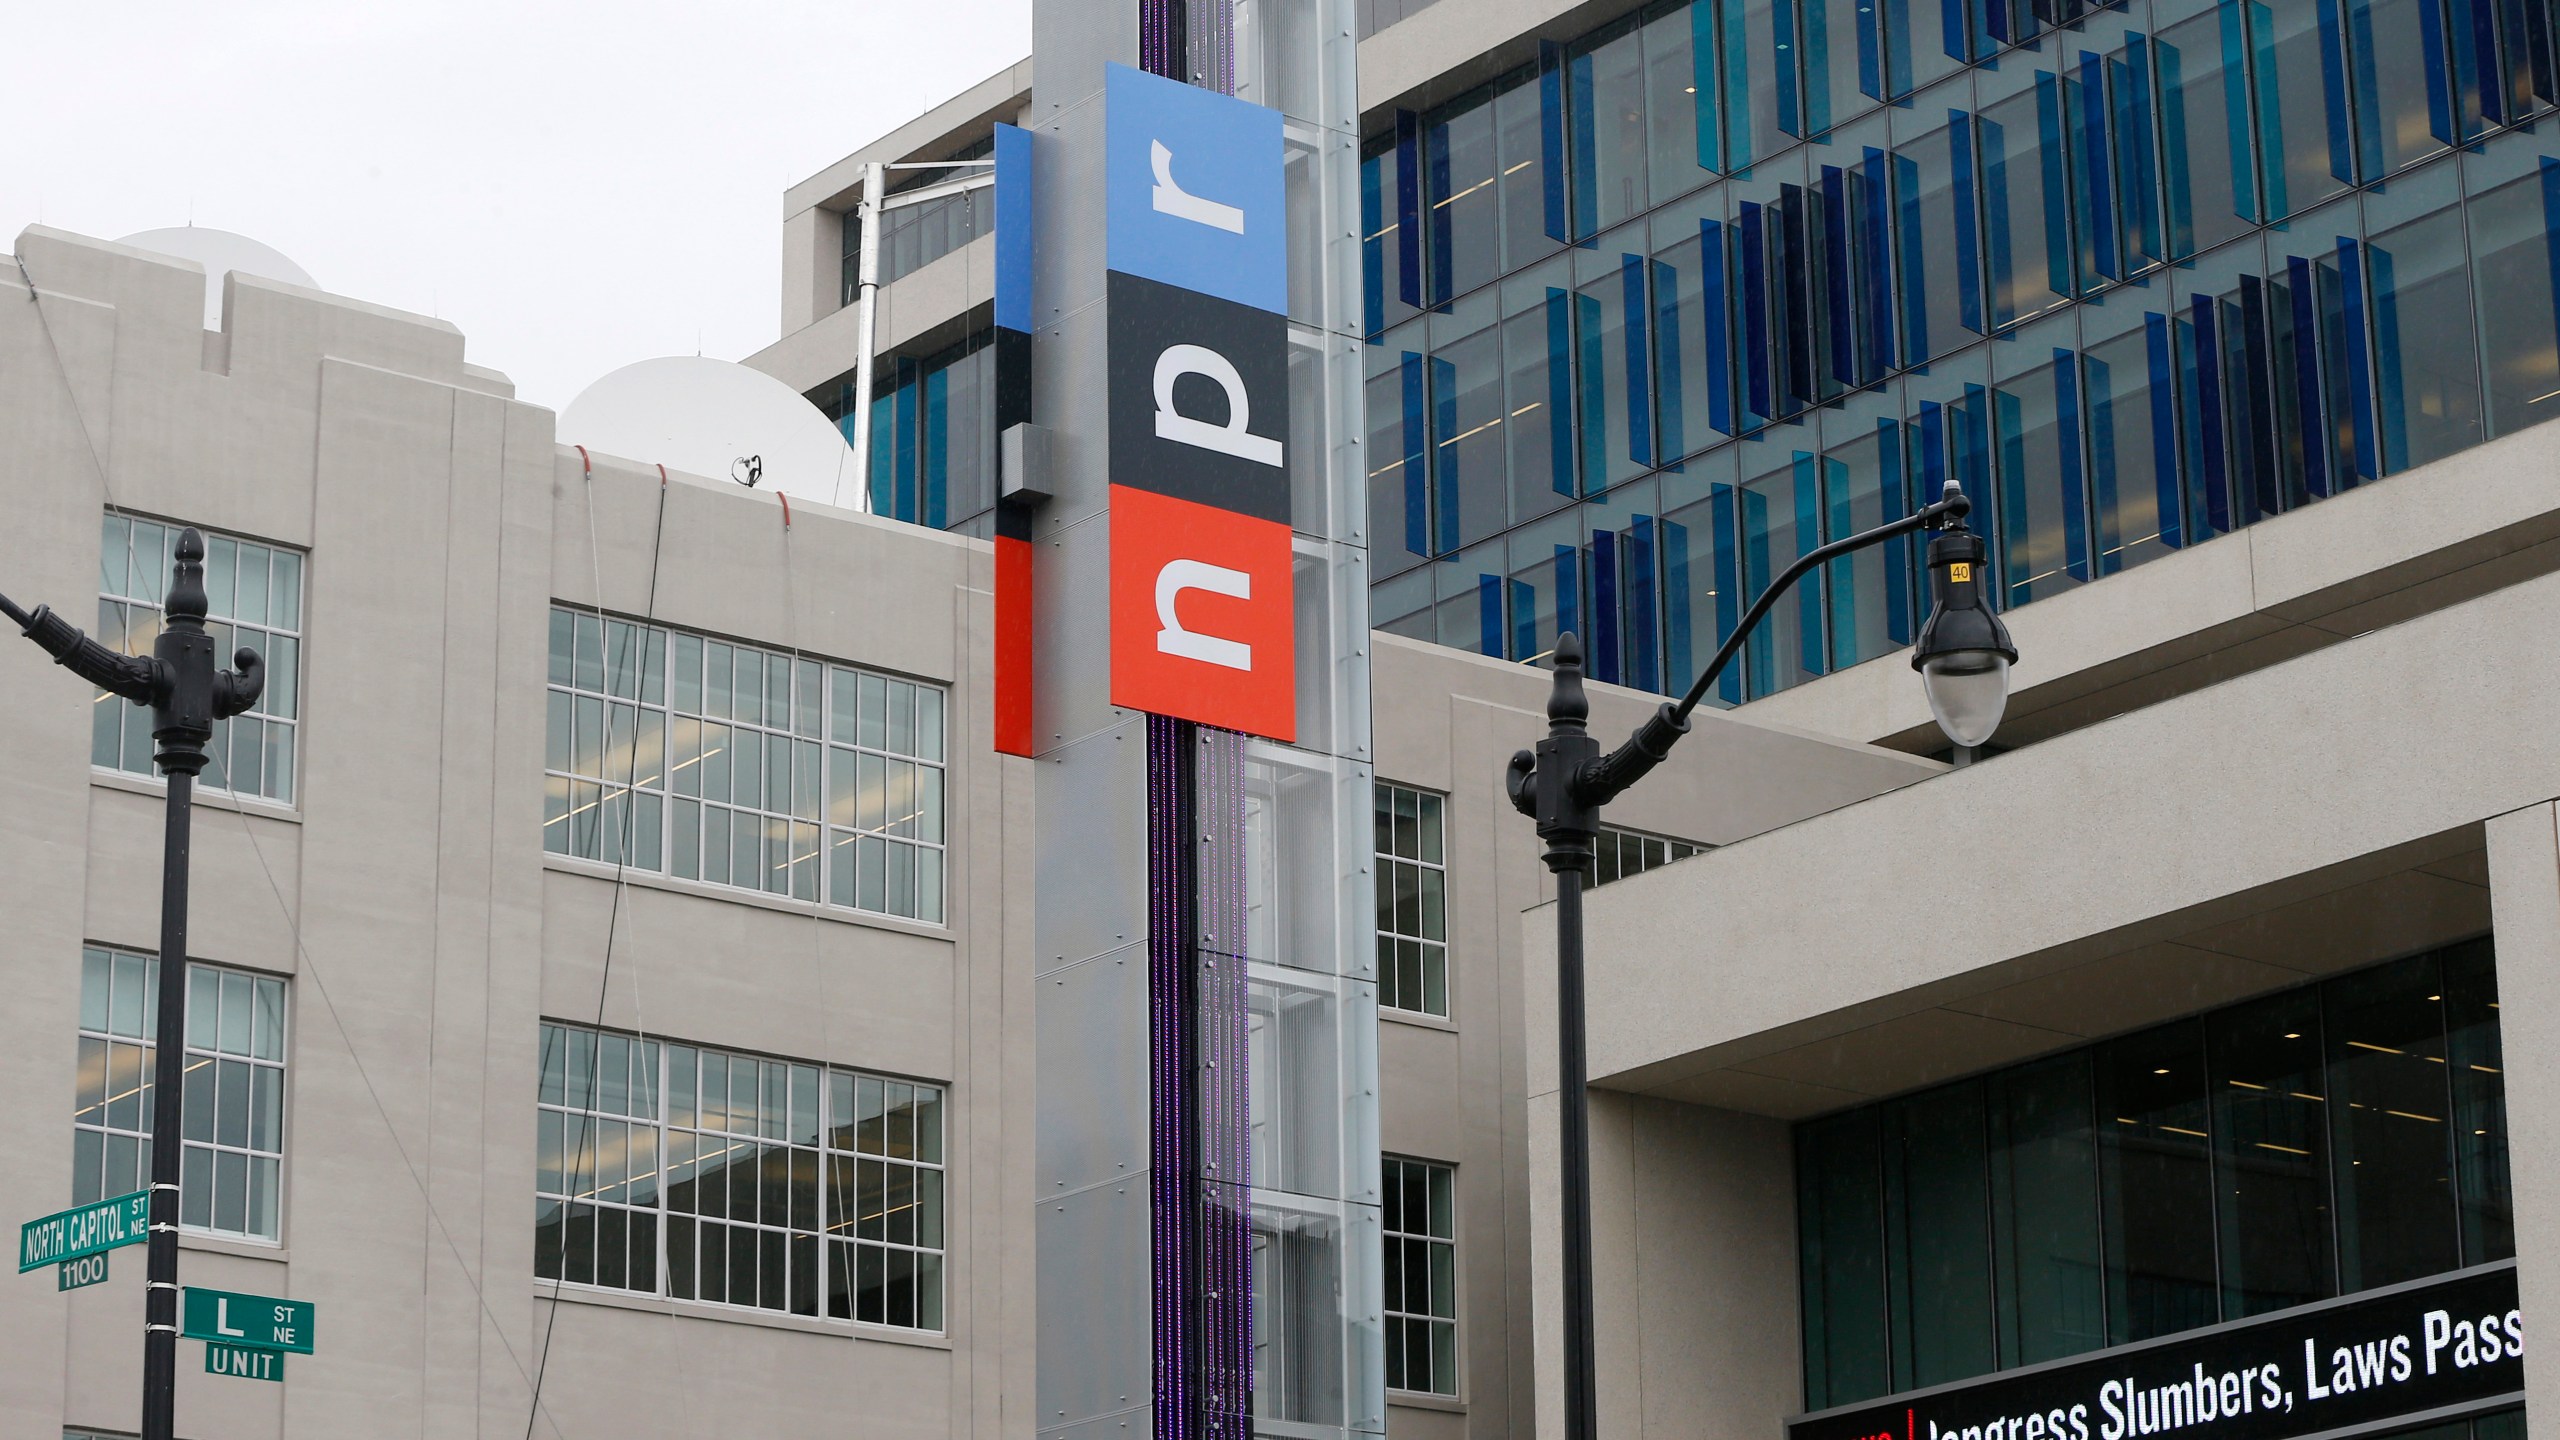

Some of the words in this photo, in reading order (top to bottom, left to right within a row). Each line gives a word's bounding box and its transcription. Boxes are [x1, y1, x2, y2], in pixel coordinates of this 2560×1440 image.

[1151, 138, 1284, 672] npr
[1952, 565, 1969, 580] 40
[26, 1219, 64, 1264] NORTH
[70, 1203, 125, 1252] CAPITOL
[131, 1197, 146, 1215] ST
[130, 1217, 146, 1236] NE
[63, 1255, 104, 1288] 1100
[217, 1298, 244, 1337] L
[273, 1305, 295, 1324] ST
[273, 1326, 295, 1345] NE
[212, 1347, 274, 1379] UNIT
[1929, 1403, 2089, 1440] ress
[2100, 1362, 2294, 1440] Slumbers,
[2305, 1333, 2412, 1401] Laws
[2424, 1309, 2524, 1376] Pass
